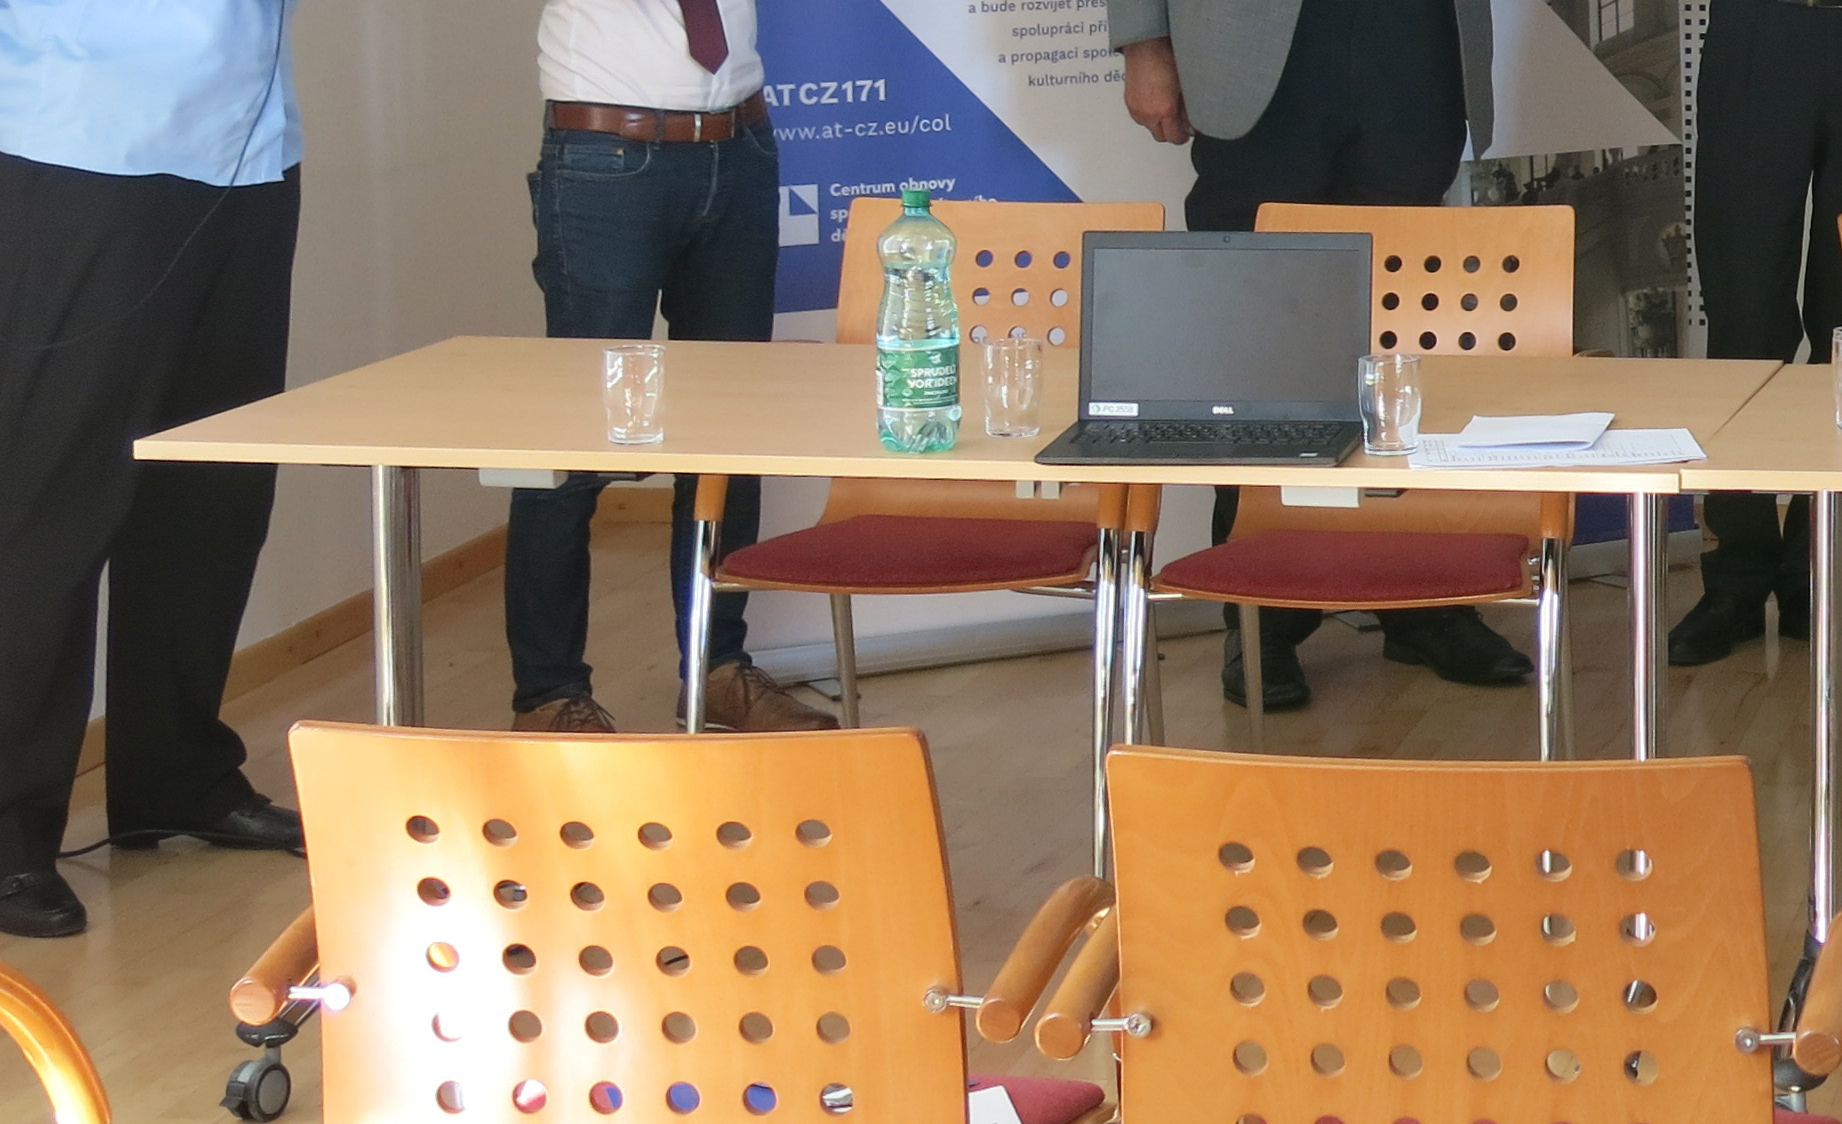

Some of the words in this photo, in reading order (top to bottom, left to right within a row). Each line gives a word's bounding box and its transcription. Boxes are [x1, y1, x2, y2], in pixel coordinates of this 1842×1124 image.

[968, 4, 976, 14] a
[981, 0, 1016, 13] bude
[1012, 23, 1084, 39] spolupráci
[998, 54, 1006, 64] a
[1011, 48, 1078, 65] propagaci
[1028, 72, 1099, 87] kulturního
[773, 114, 952, 142] ww.at-cz.eu/col
[829, 180, 896, 198] Centrum
[1212, 406, 1234, 414] DELL
